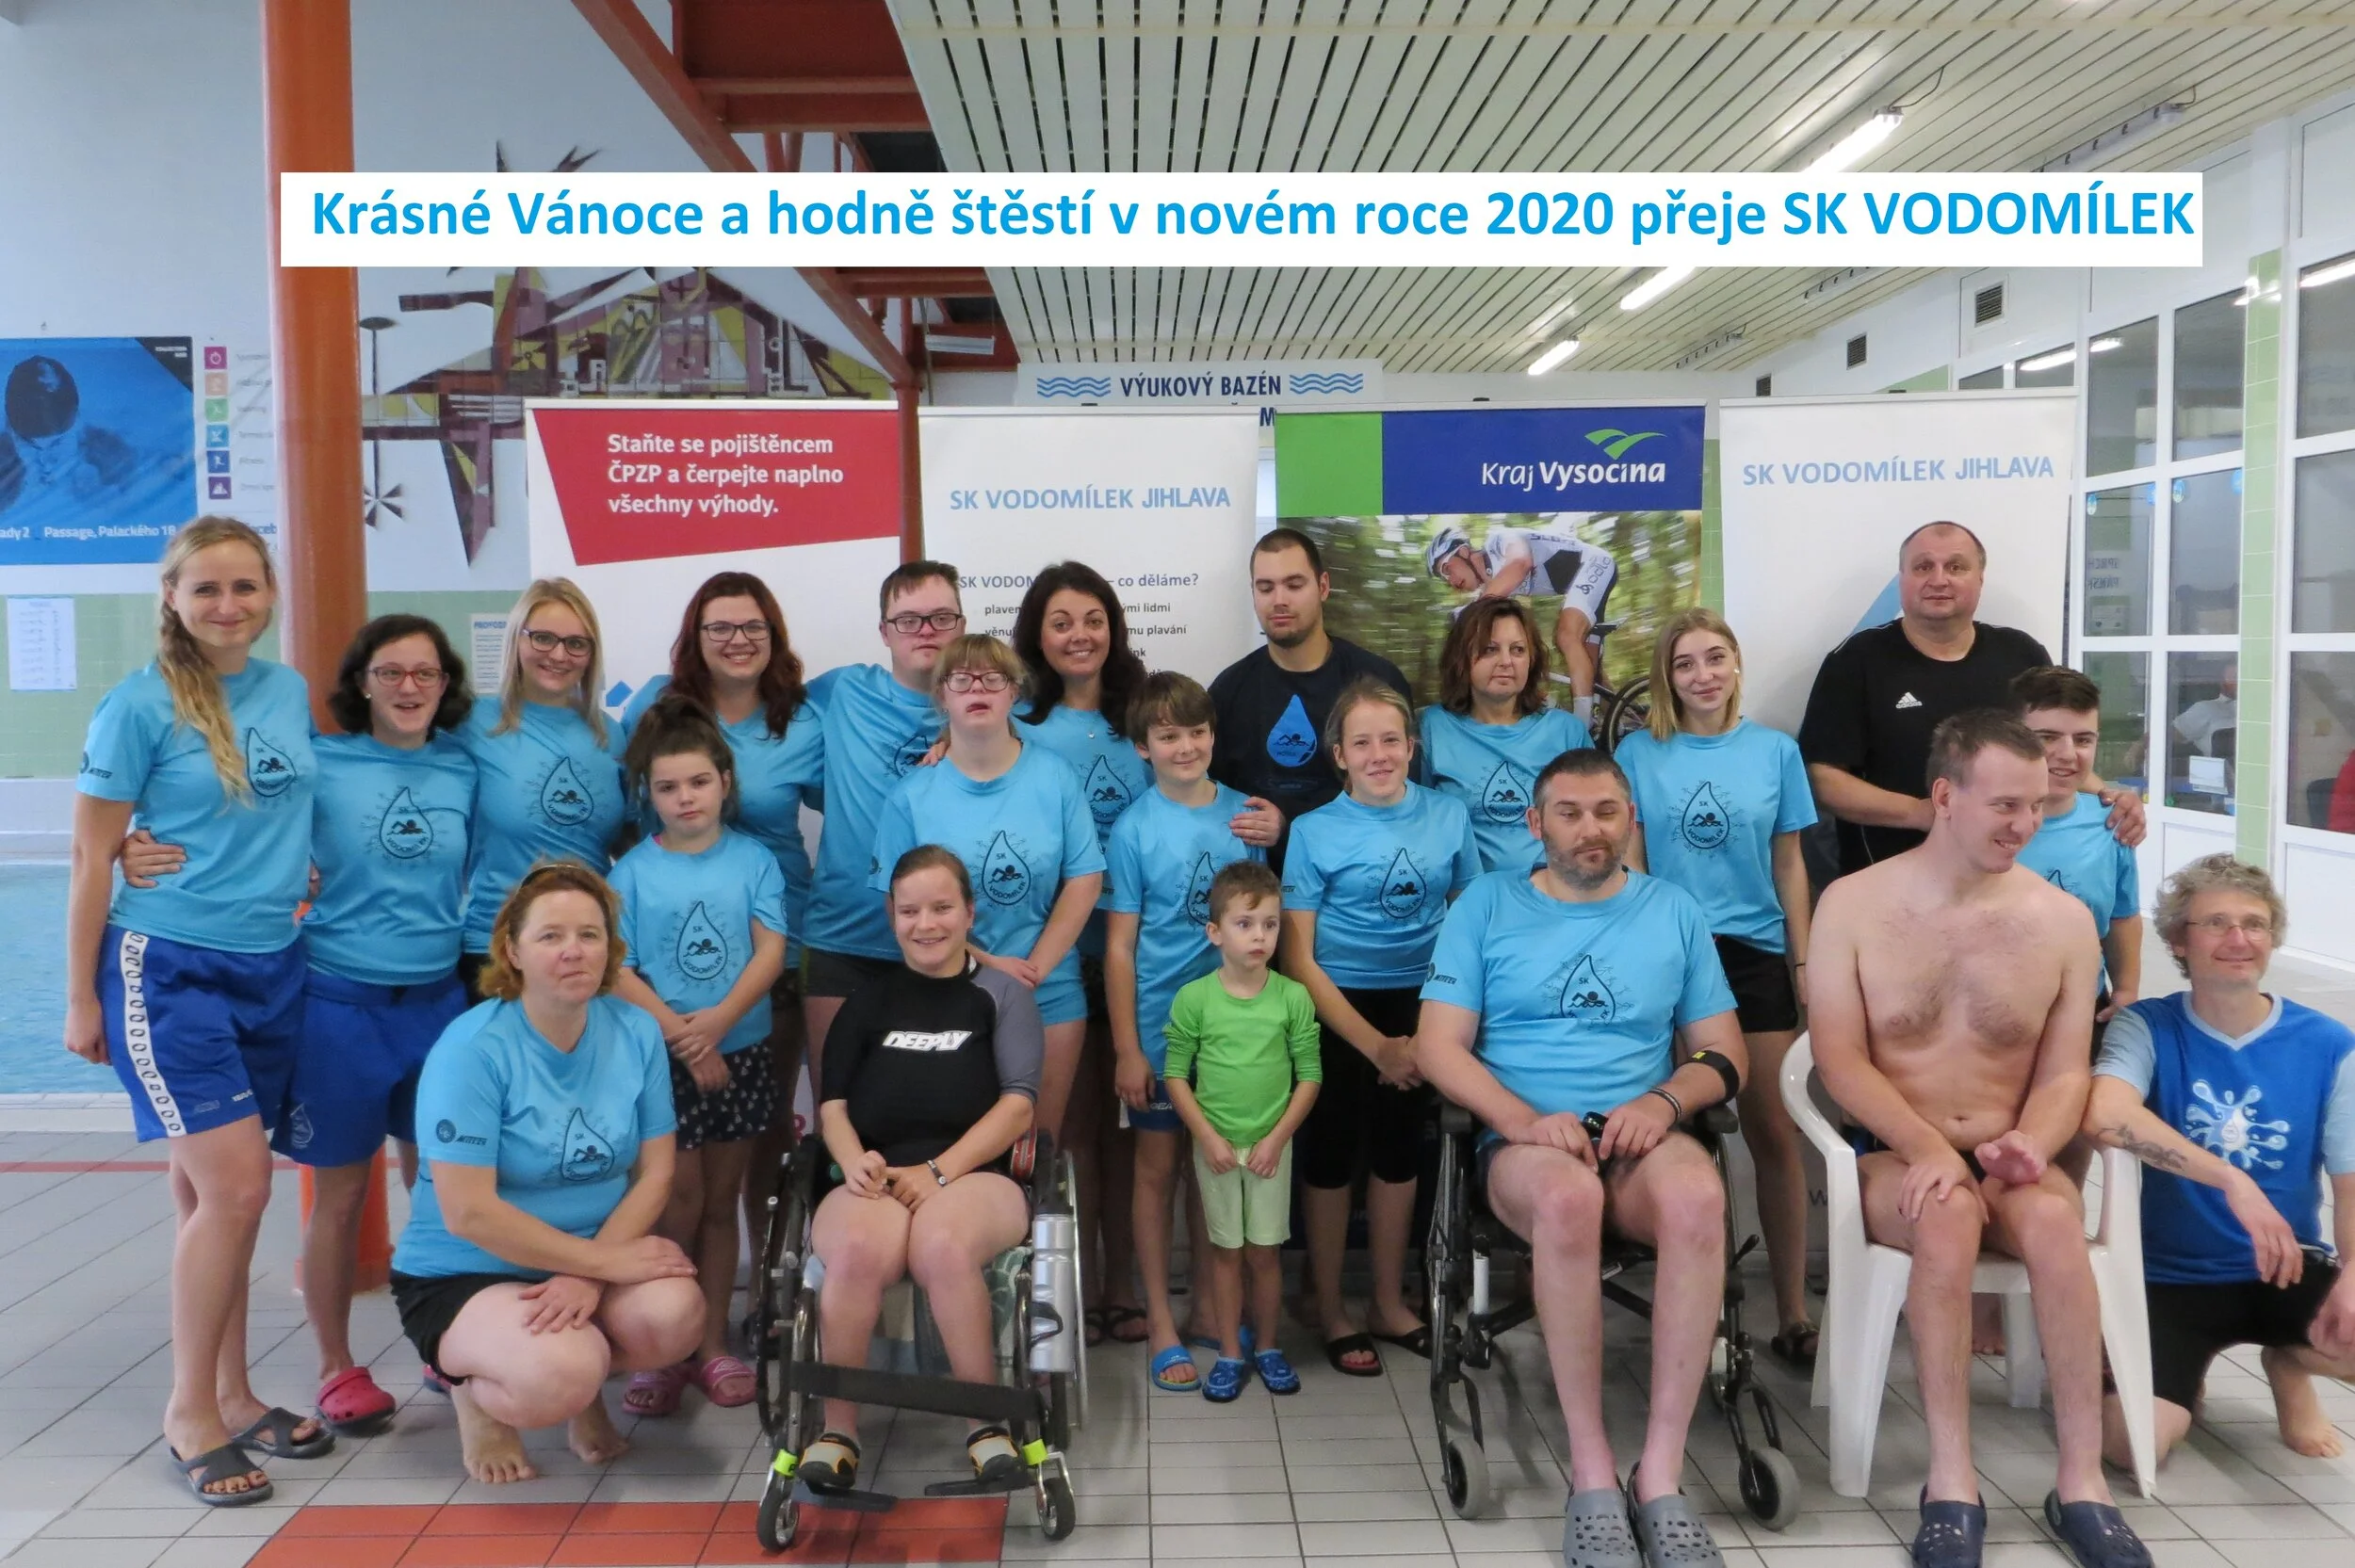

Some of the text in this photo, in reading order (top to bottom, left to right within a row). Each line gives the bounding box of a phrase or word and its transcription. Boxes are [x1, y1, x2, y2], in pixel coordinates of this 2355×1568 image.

[1119, 370, 1281, 397] VÝUKOVÝ BAZÉN
[608, 433, 834, 458] Staňte se pojištěncem
[608, 461, 844, 488] ČPZP a čerpejte naplno
[1482, 462, 1535, 493] Kraj
[1744, 455, 2055, 486] SK VODOMÍLEK JIHLAVA
[608, 493, 780, 518] všechny výhody.
[950, 484, 1231, 510] SK VODOMÍLEK JIHLAVA
[0, 526, 21, 541] ady
[43, 526, 97, 541] Passage,
[960, 575, 977, 588] SK
[1117, 577, 1134, 587] co
[1138, 573, 1199, 587] děláme?
[1143, 599, 1171, 612] lidmi
[1147, 624, 1187, 638] plavání
[882, 1030, 973, 1052] DEEPLY
